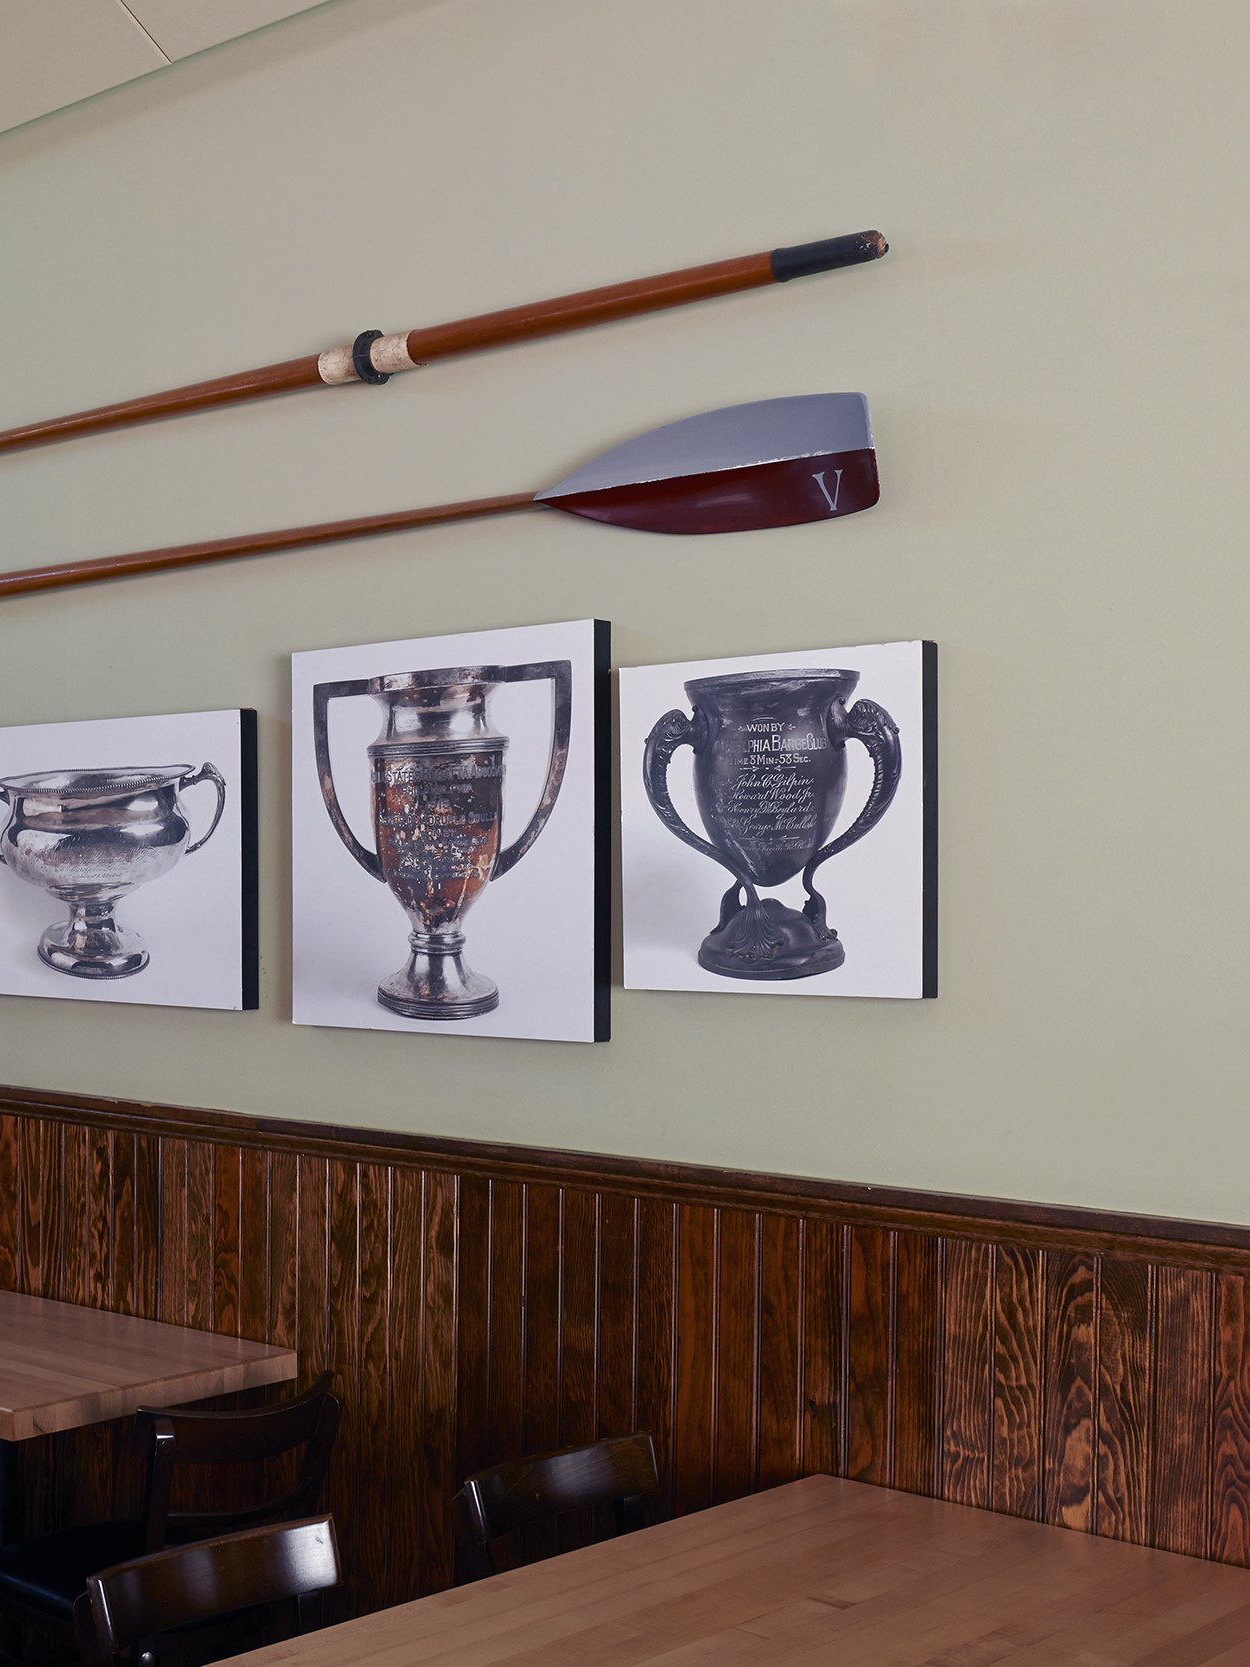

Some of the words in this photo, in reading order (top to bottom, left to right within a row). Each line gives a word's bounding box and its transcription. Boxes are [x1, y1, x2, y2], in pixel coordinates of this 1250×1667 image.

[812, 469, 843, 512] V
[746, 722, 770, 733] WON
[771, 722, 785, 733] BY
